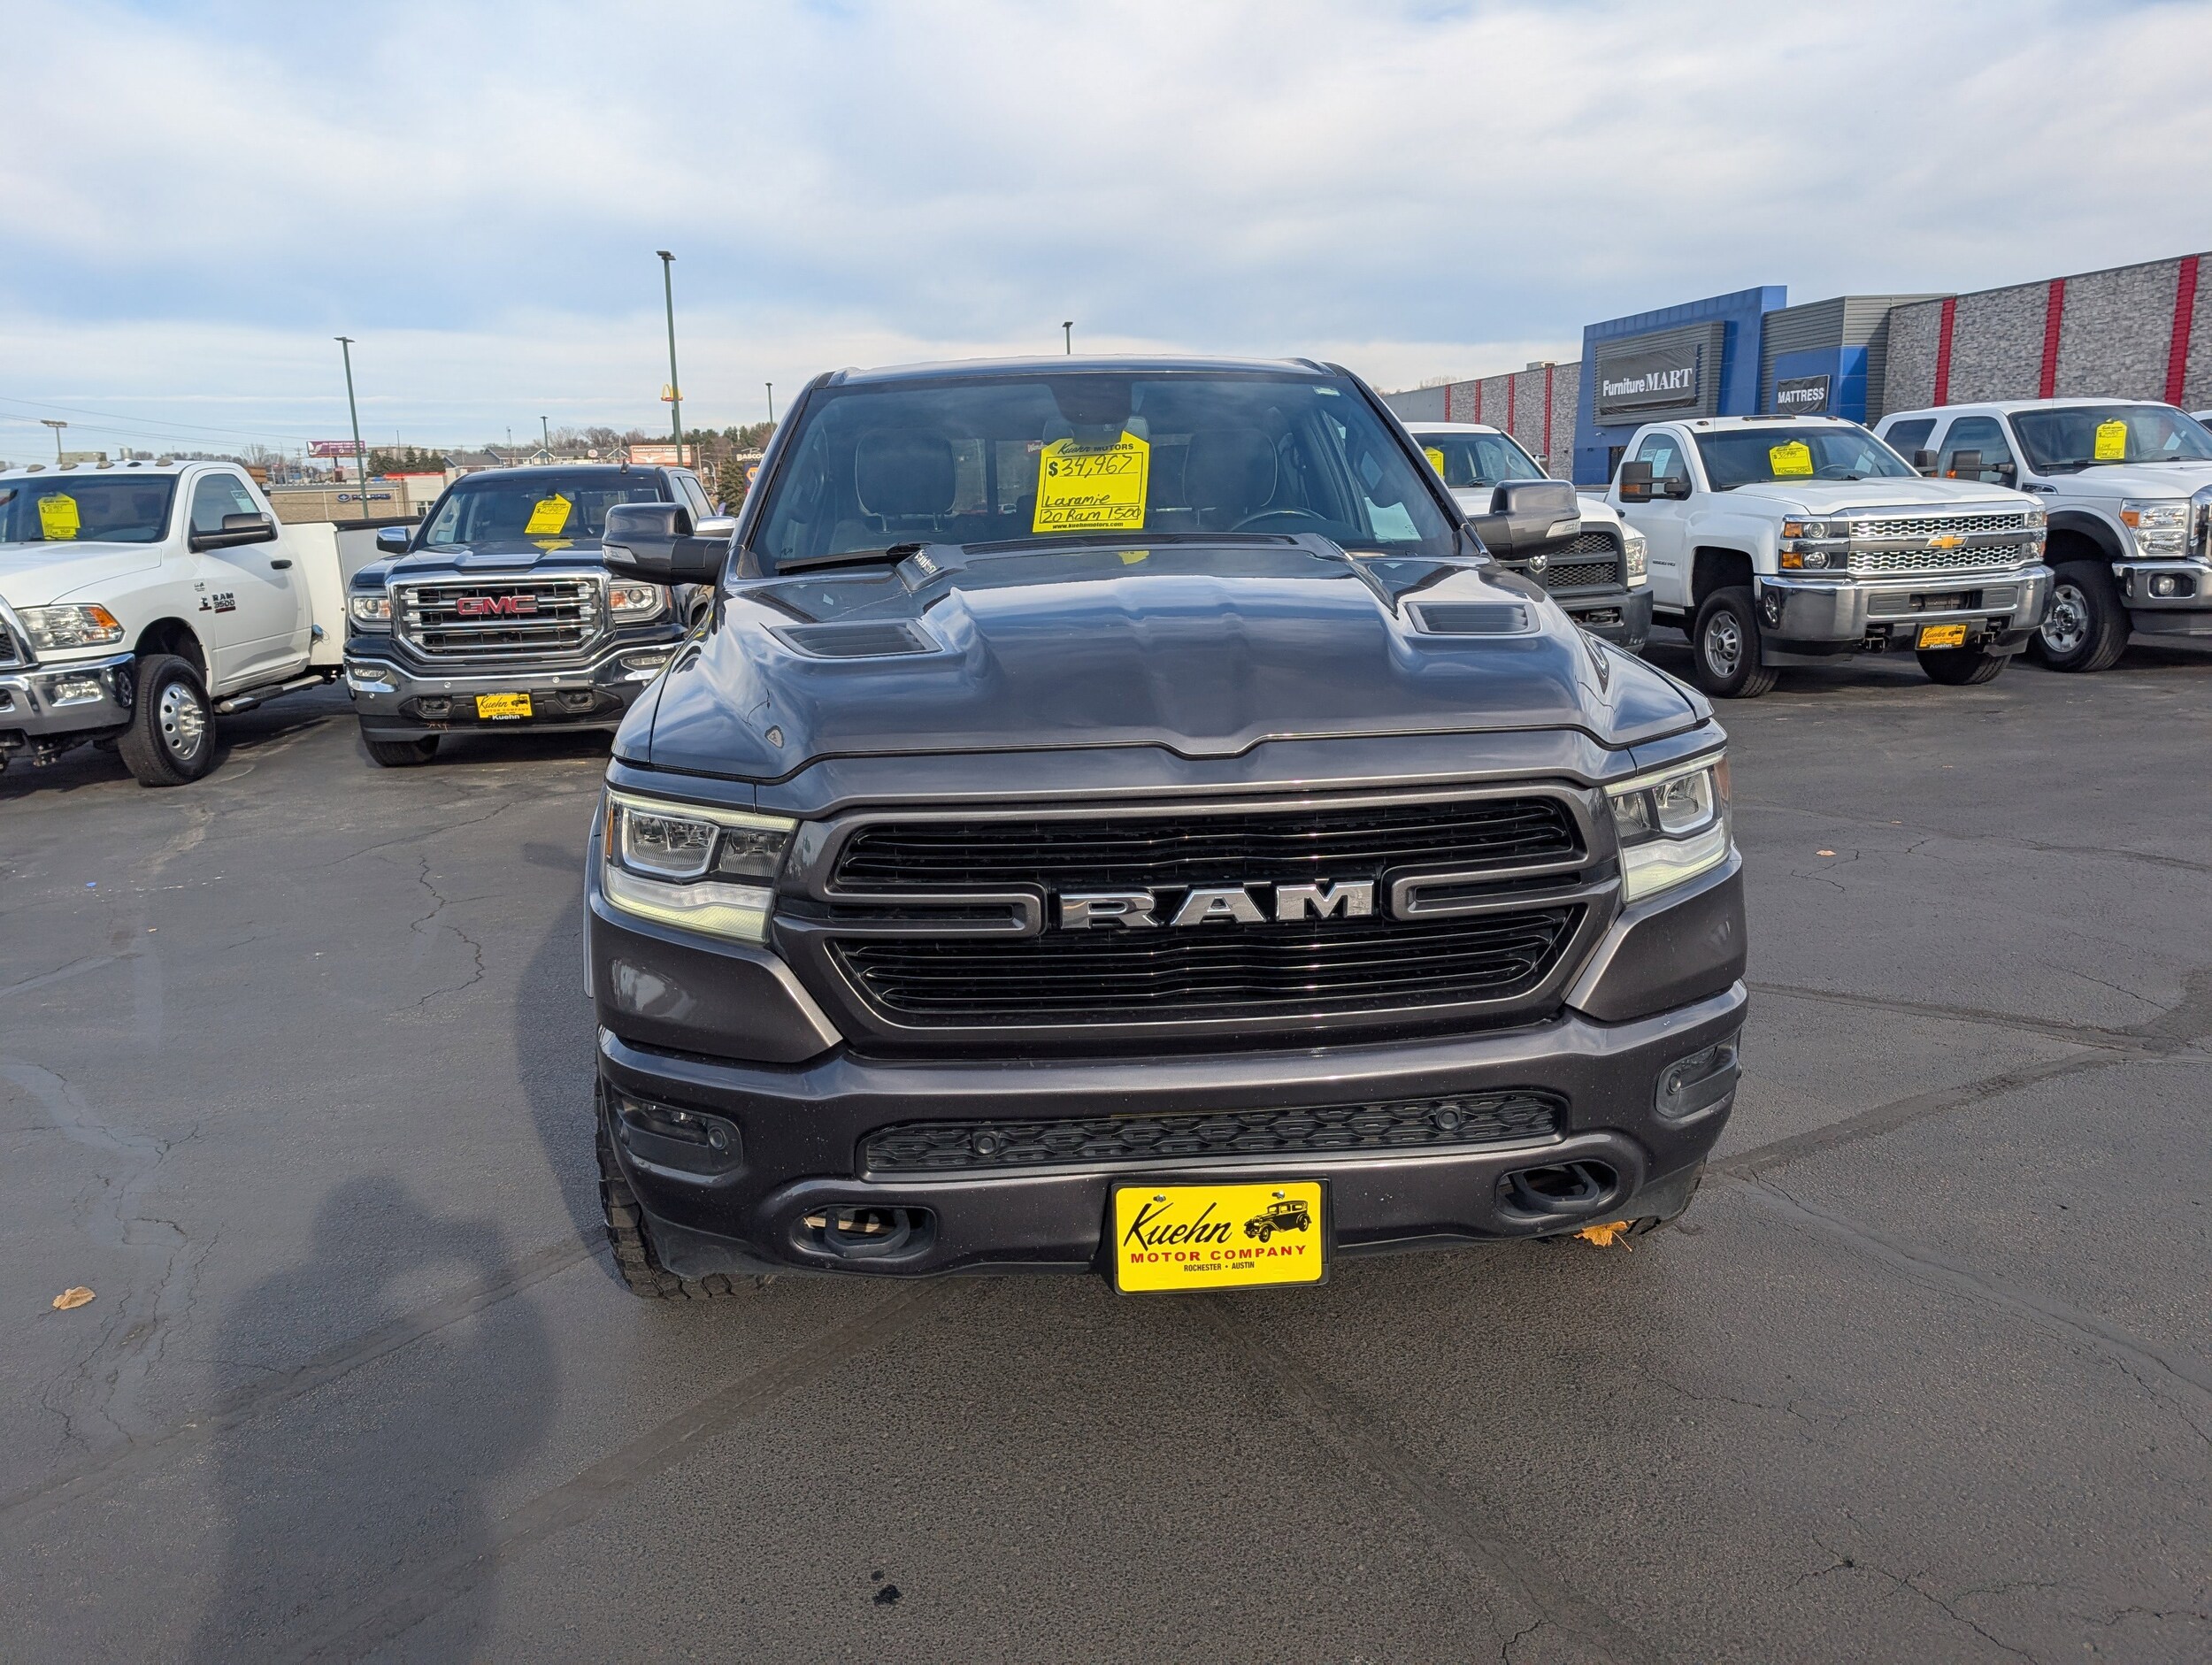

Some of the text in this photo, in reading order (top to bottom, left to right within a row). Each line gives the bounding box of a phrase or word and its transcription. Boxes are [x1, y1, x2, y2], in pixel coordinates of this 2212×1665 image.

[1778, 387, 1824, 404] MATTRESS
[1057, 442, 1134, 455] Kuehn MOTORS
[1046, 494, 1110, 507] Laramie
[1042, 507, 1141, 523] 20 Ram 1500
[212, 592, 234, 602] RAM
[214, 599, 235, 609] 3500
[457, 595, 538, 615] GMC
[479, 696, 509, 710] Kuehn
[1060, 880, 1374, 929] RAM
[1123, 1201, 1233, 1252] Kuehn
[1131, 1245, 1307, 1263] MOTOR COMPANY
[1184, 1263, 1222, 1272] ROCHESTER
